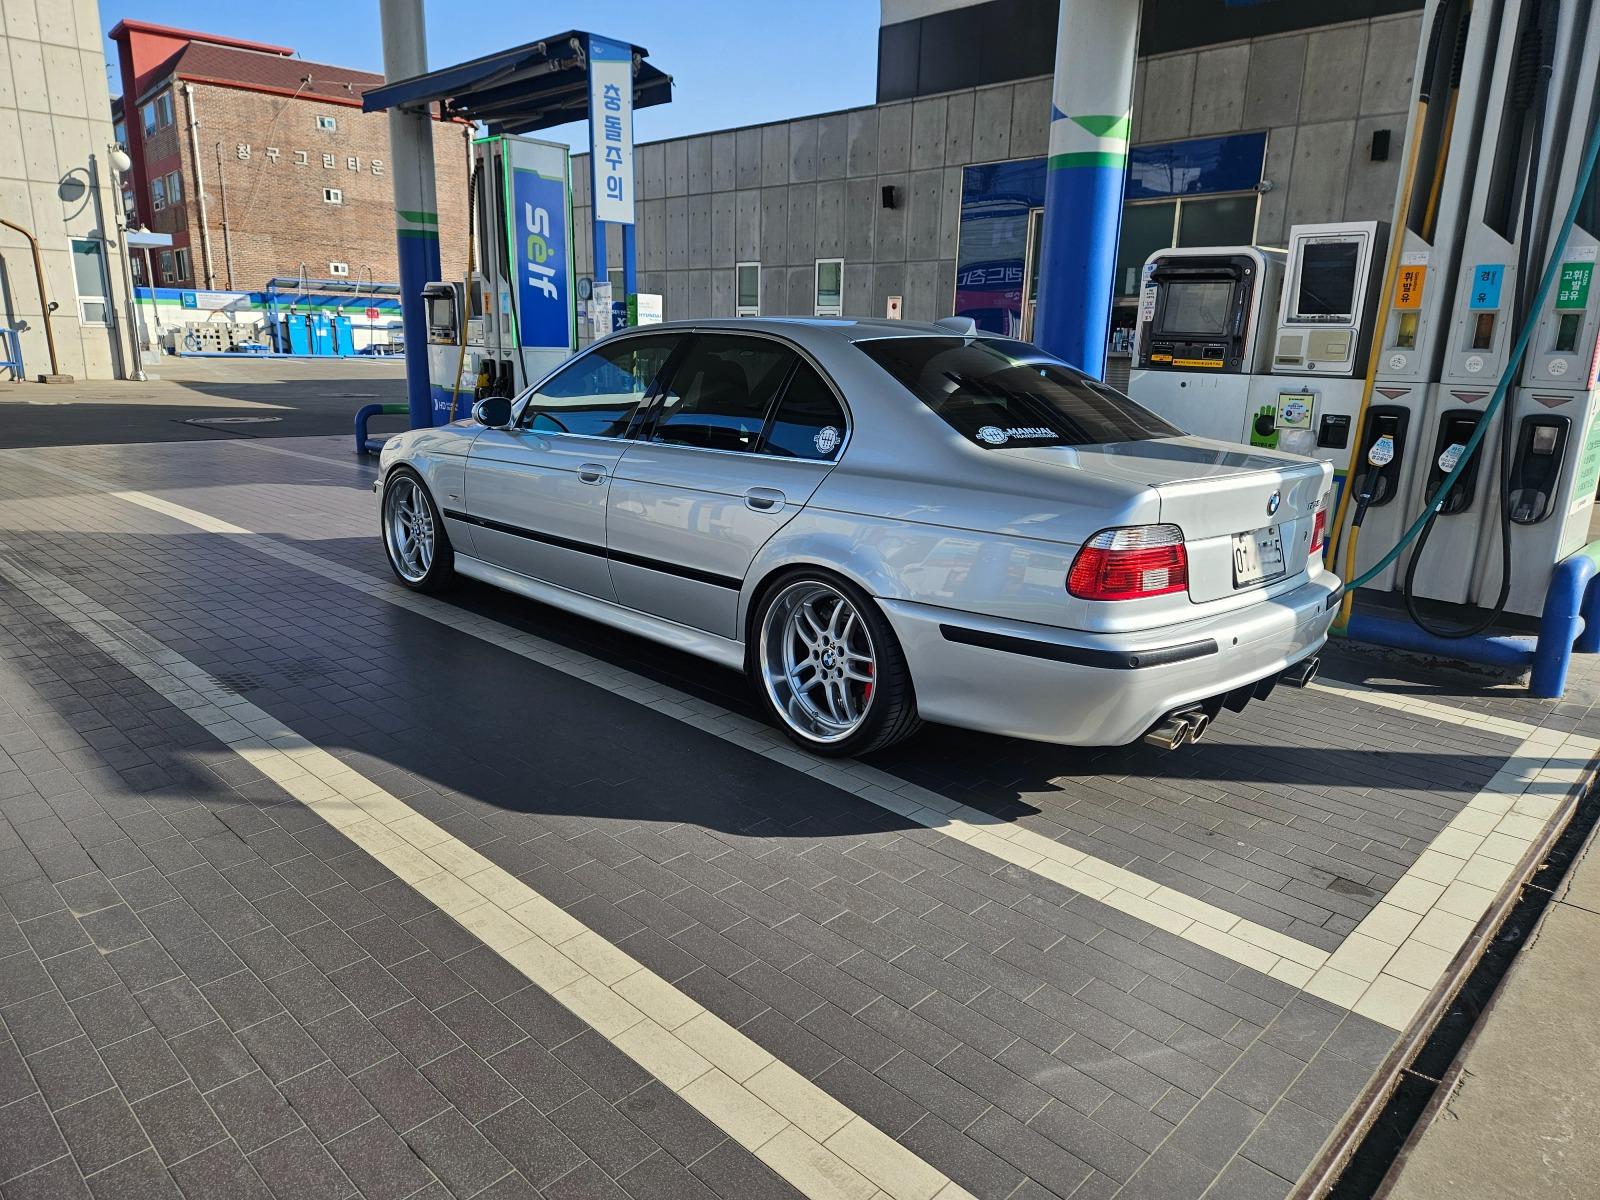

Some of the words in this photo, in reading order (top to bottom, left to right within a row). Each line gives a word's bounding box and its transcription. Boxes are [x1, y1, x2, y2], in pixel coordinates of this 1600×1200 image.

[236, 143, 385, 176] 청구그린타운
[603, 84, 623, 202] 충돌주의
[1400, 271, 1413, 303] 휘발유
[1477, 271, 1491, 304] 경유
[1006, 427, 1055, 436] MANUAL
